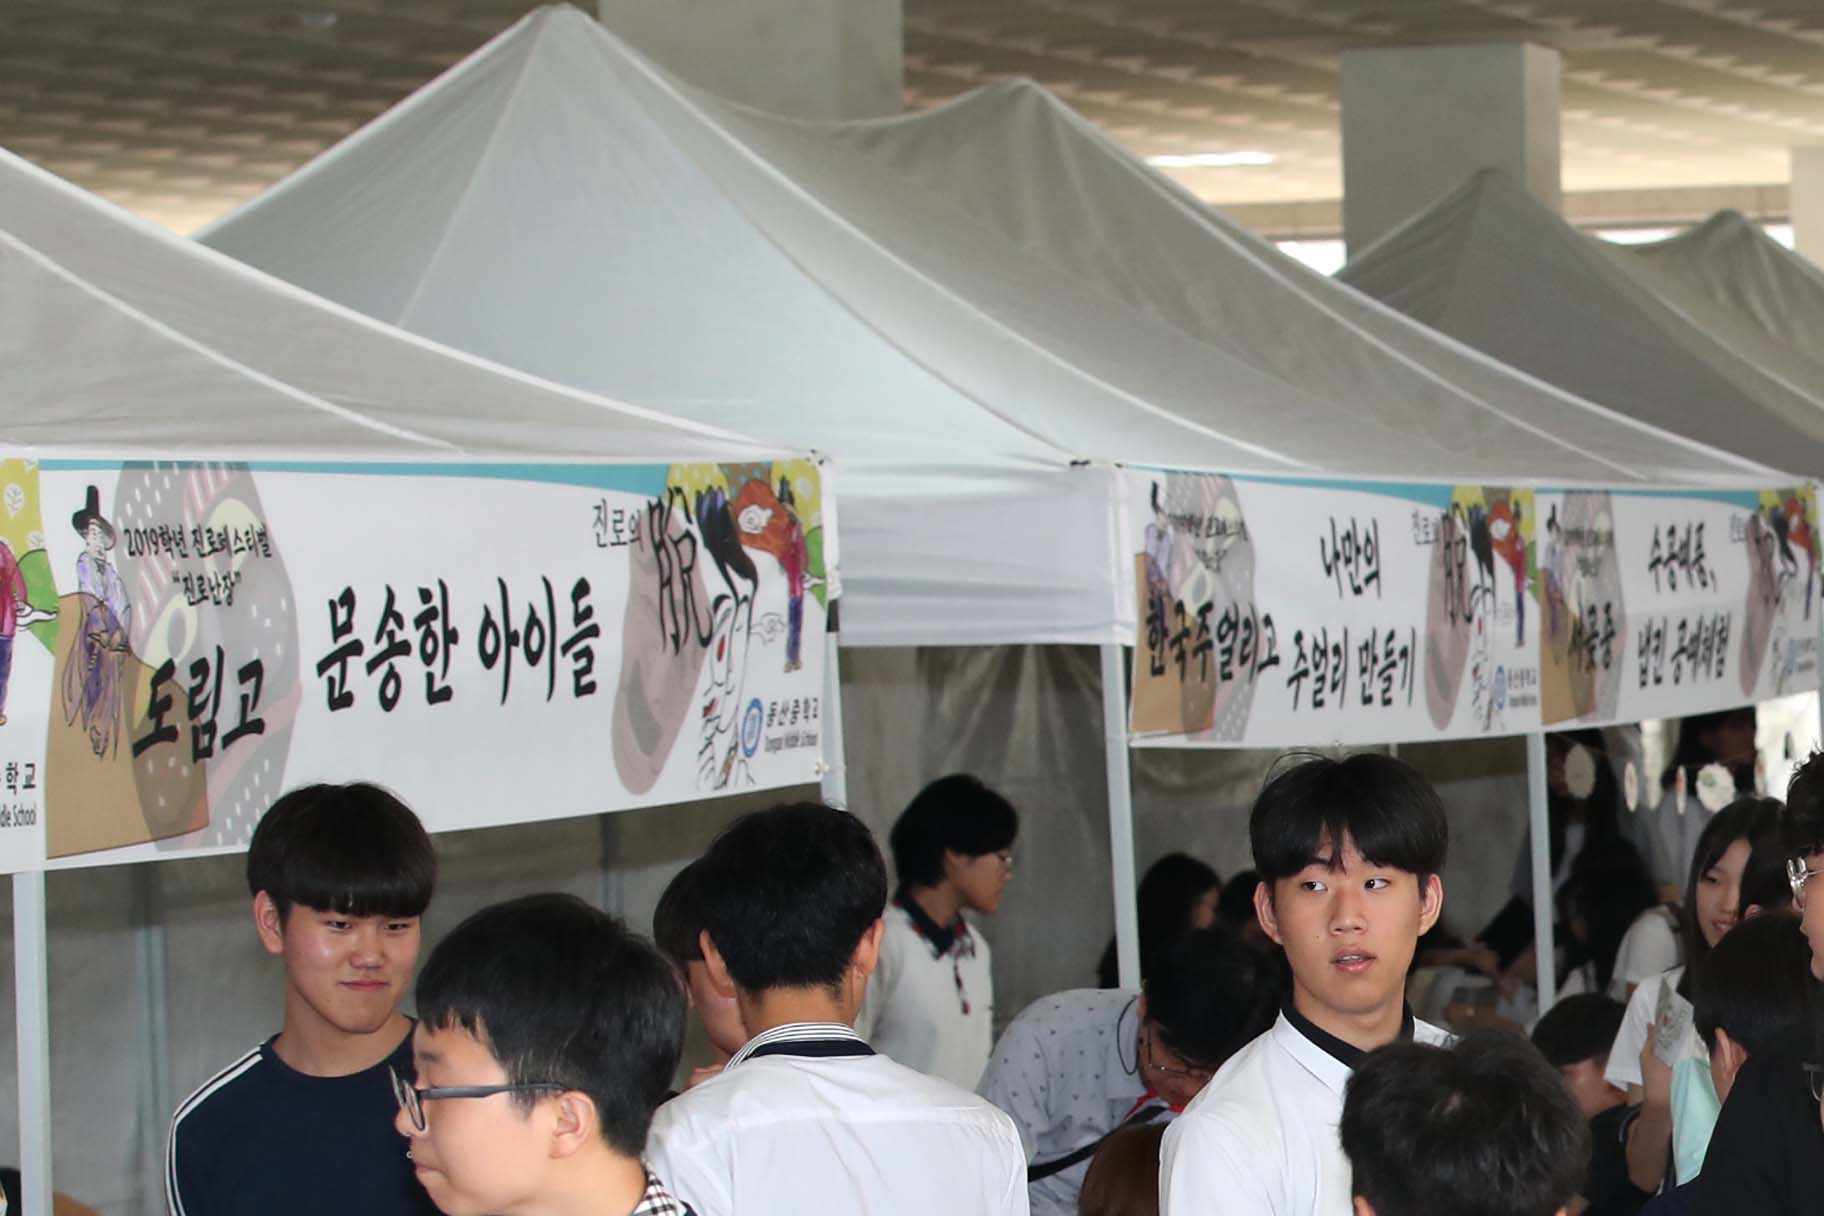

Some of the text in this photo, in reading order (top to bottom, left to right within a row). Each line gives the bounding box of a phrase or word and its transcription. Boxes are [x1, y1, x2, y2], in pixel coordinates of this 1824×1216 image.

[124, 523, 189, 559] 2019학년
[593, 498, 644, 553] 진로의
[1319, 516, 1382, 599] 나만의
[132, 575, 602, 764] 도림고 문송한 아이들
[1146, 594, 1416, 711] 한국주얼리고 주얼리 만들기
